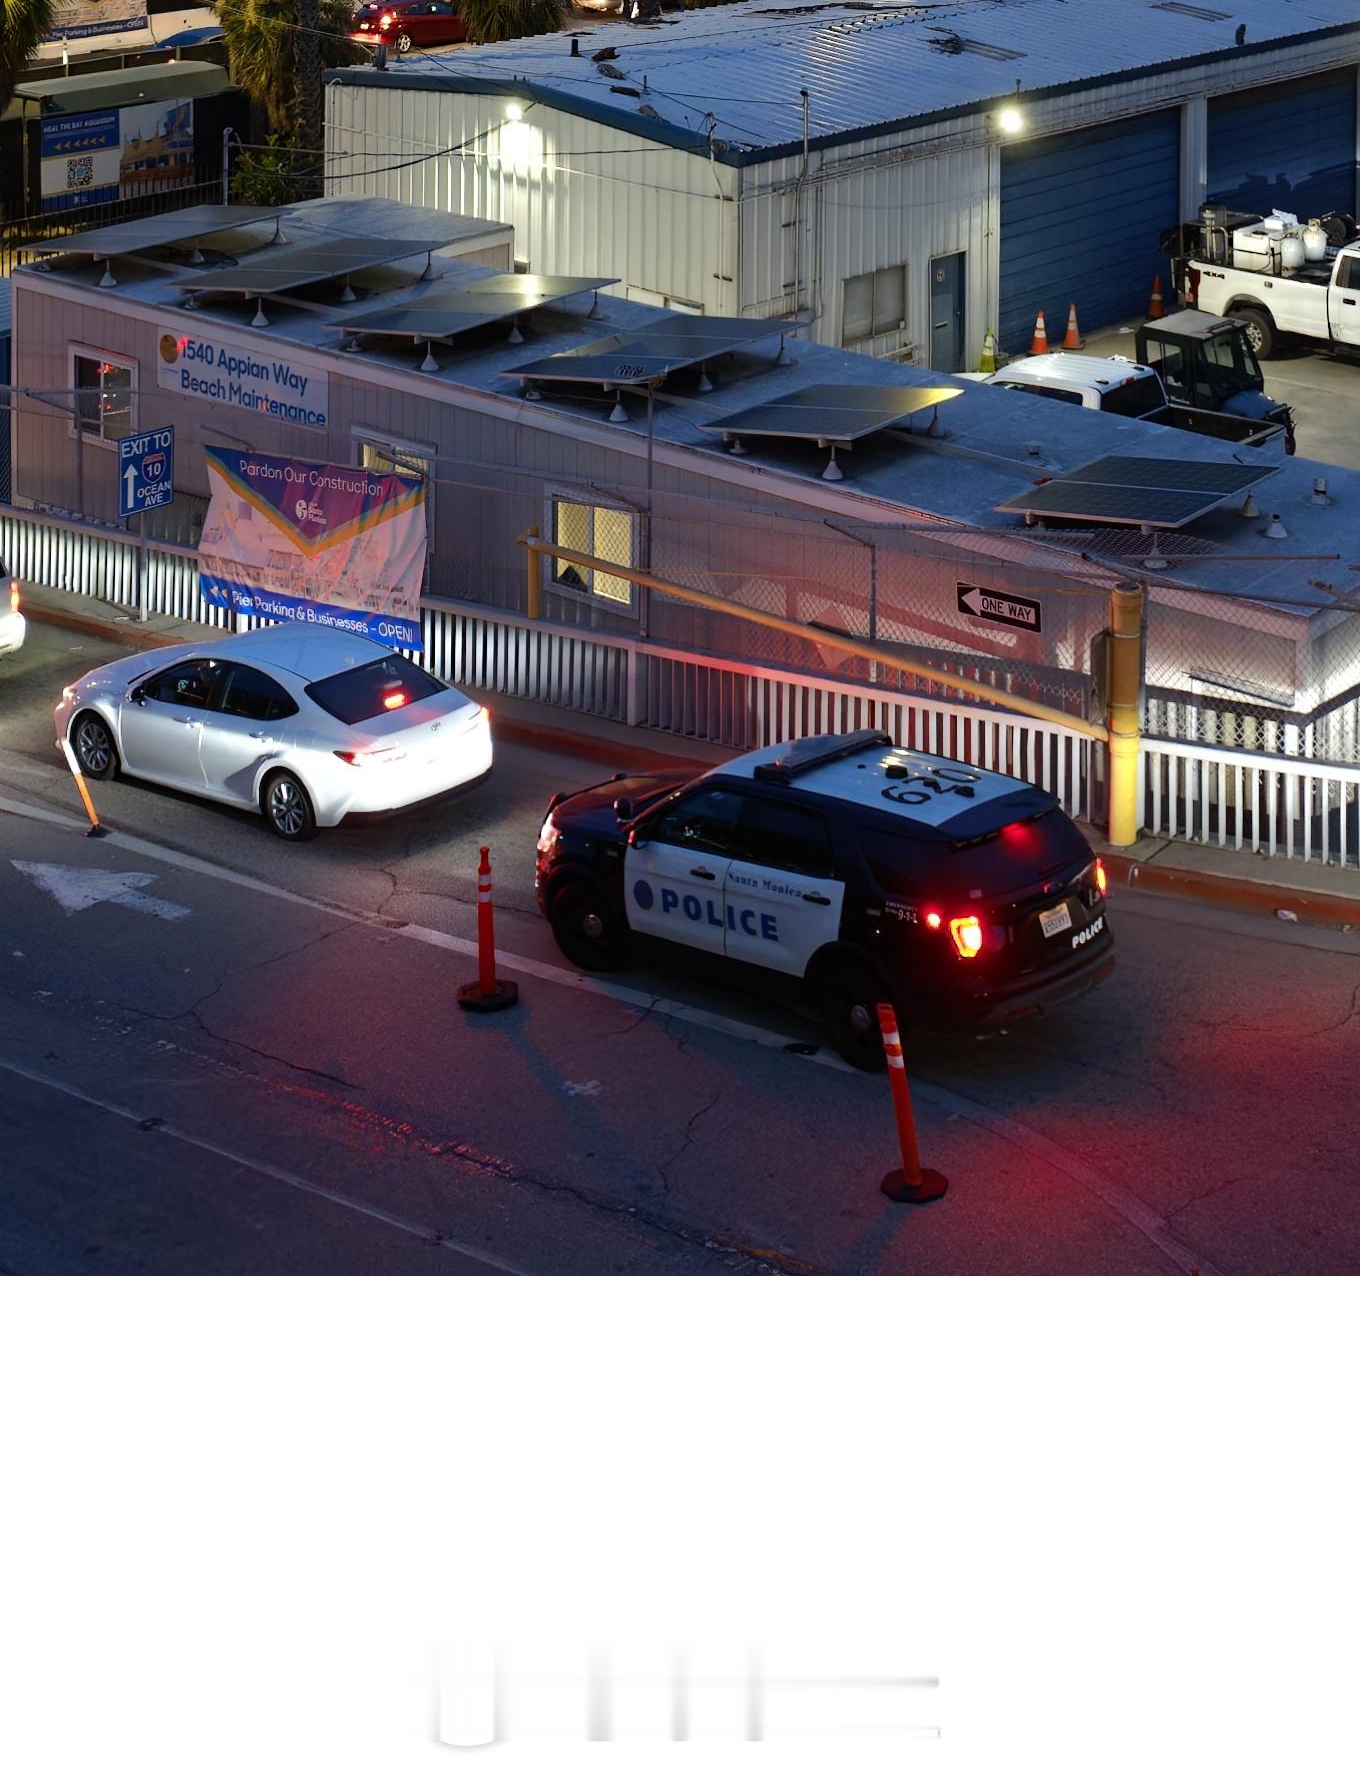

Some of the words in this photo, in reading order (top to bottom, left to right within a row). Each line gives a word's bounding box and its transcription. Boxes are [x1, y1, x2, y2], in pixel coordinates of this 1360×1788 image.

[43, 124, 59, 133] HEAL
[60, 123, 71, 131] THE
[180, 339, 214, 365] 1540
[217, 349, 269, 381] Appian
[272, 362, 308, 396] Way
[181, 368, 226, 400] Beach
[229, 382, 326, 427] Maintenance
[121, 437, 151, 458] EXIT
[153, 431, 171, 449] TO
[146, 462, 161, 477] 10
[240, 460, 282, 480] Pardon
[284, 467, 307, 484] Our
[309, 472, 384, 497] Construction
[137, 480, 171, 498] OCEAN
[144, 492, 164, 507] AVE
[232, 590, 254, 608] Pier
[255, 596, 295, 619] Parking
[296, 606, 305, 619] &
[307, 609, 369, 634] Businesses
[379, 621, 413, 643] OPEN!
[981, 597, 1004, 614] ONE
[1008, 603, 1032, 621] WAY
[661, 887, 779, 942] POLICE
[1072, 916, 1103, 949] POLICE
